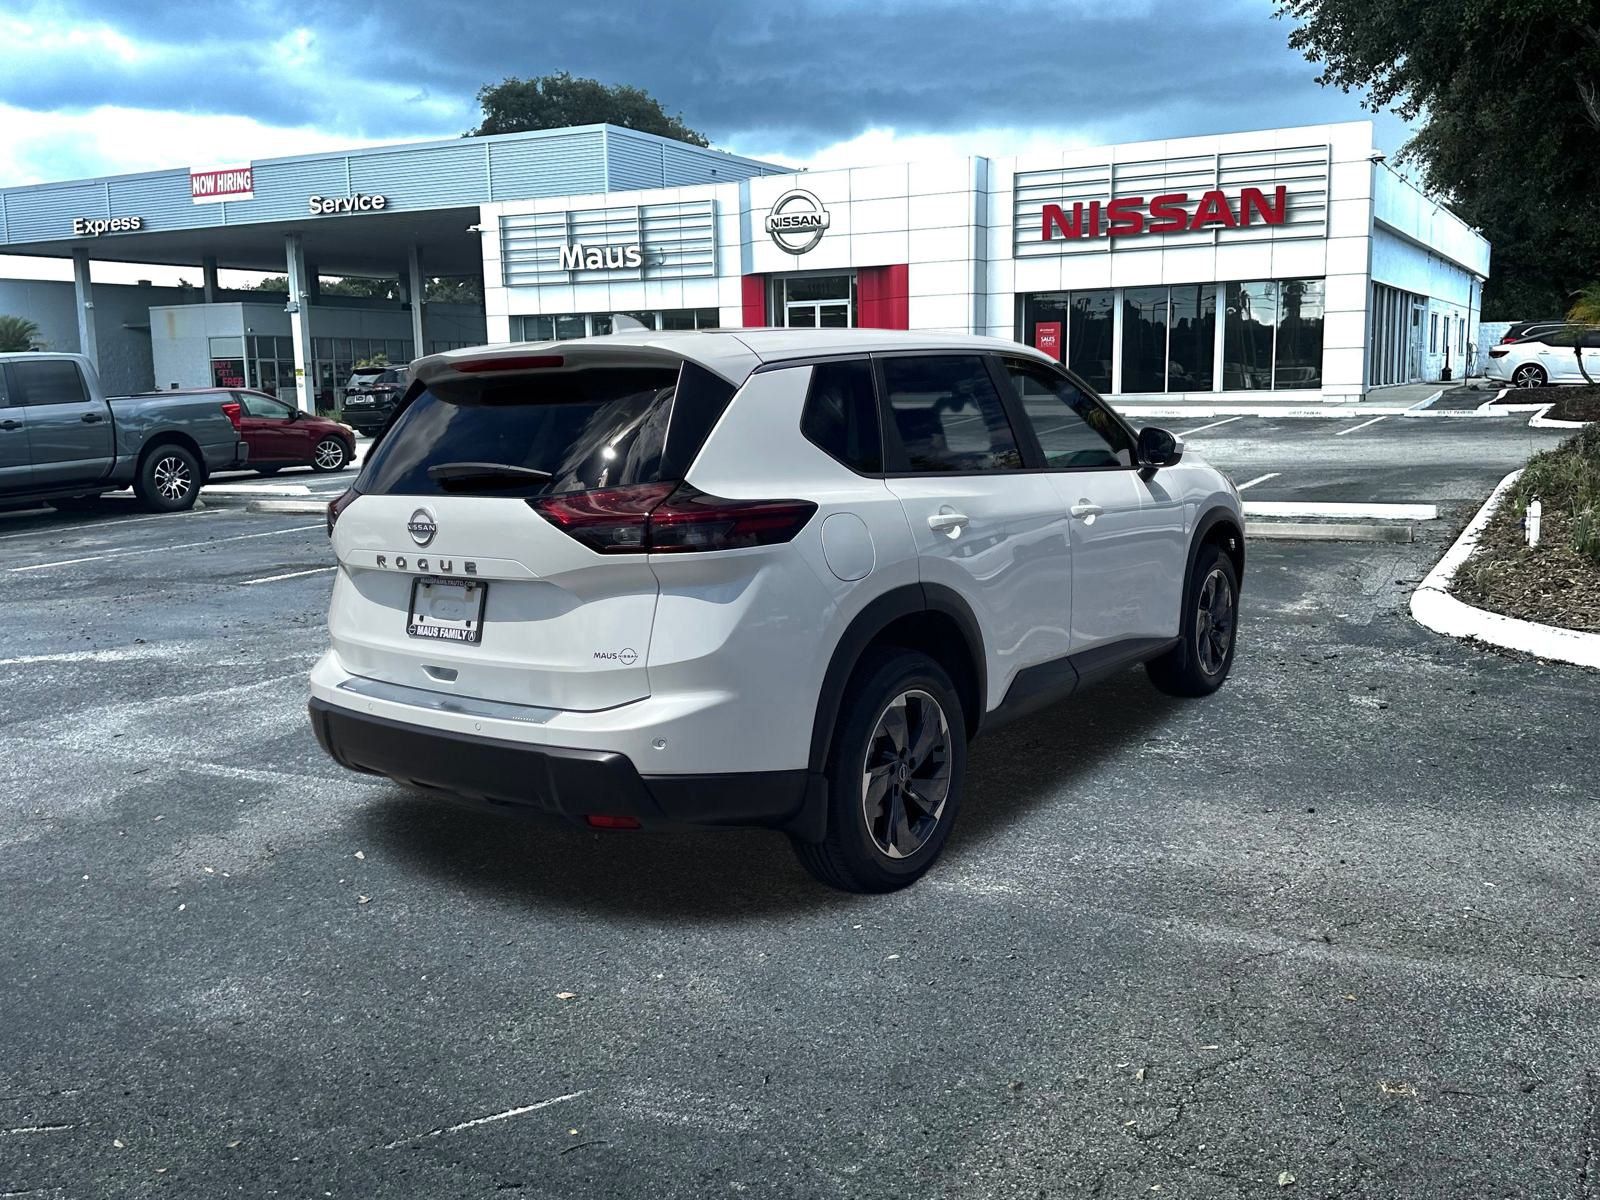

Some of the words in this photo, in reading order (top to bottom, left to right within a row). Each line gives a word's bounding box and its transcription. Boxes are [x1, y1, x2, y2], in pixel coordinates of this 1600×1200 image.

[192, 174, 215, 195] NOW
[217, 171, 251, 192] HIRING
[309, 193, 385, 215] Service
[1042, 185, 1287, 241] NISSAN
[73, 216, 141, 237] Express
[770, 215, 822, 228] NISSAN
[560, 243, 642, 270] Maus
[223, 377, 243, 386] FREE
[376, 554, 477, 575] ROGUE
[416, 625, 439, 637] MAUS
[439, 628, 467, 641] FAMILY
[593, 652, 617, 660] MAUS
